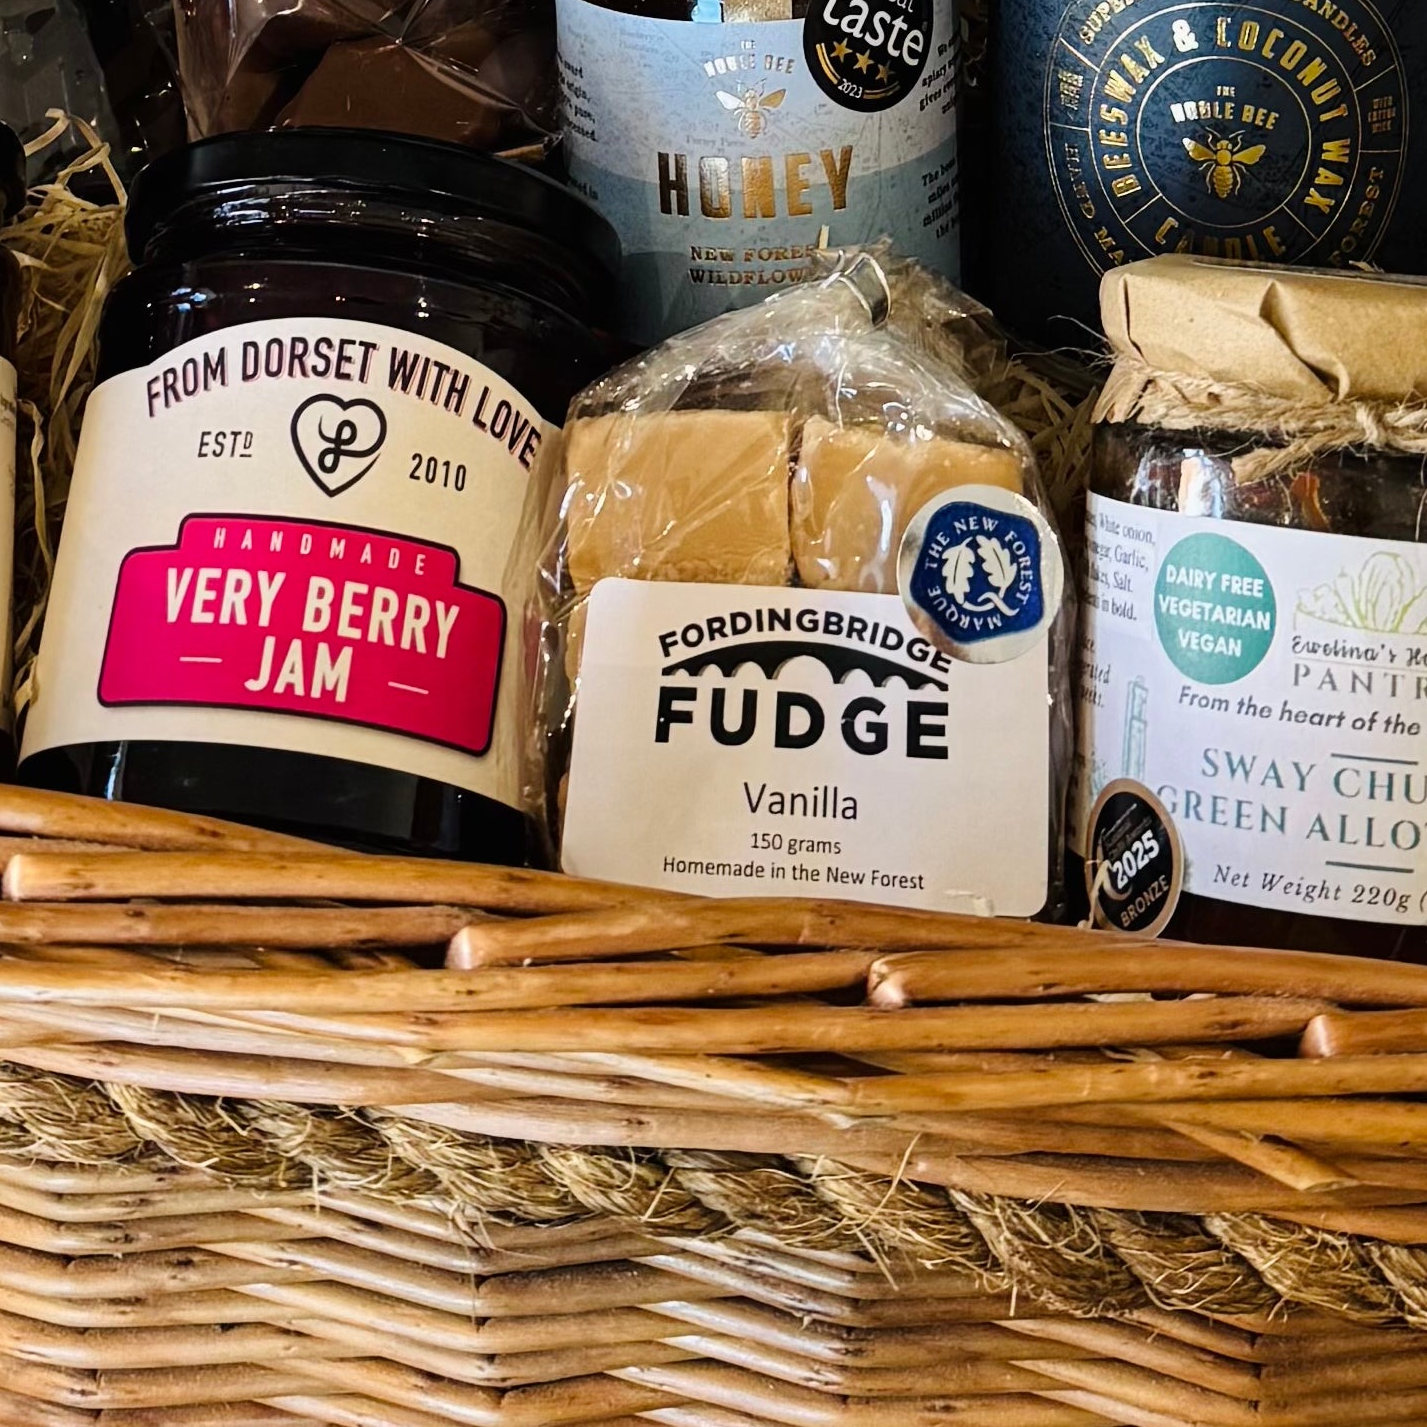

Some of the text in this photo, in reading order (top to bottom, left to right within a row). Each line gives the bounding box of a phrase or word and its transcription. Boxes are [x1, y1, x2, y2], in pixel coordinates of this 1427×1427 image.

[658, 147, 854, 218] HONEY
[1165, 565, 1264, 597] DAIRY FREE
[166, 567, 460, 660] VERY BERRY
[1158, 595, 1270, 630] VEGETARIAN
[659, 608, 952, 674] FORDINGBRIDGE
[1178, 630, 1242, 657] VEGAN
[244, 637, 353, 702] JAM
[655, 686, 949, 759] FUDGE
[743, 782, 858, 820] Vanilla
[751, 833, 842, 854] 150 grams
